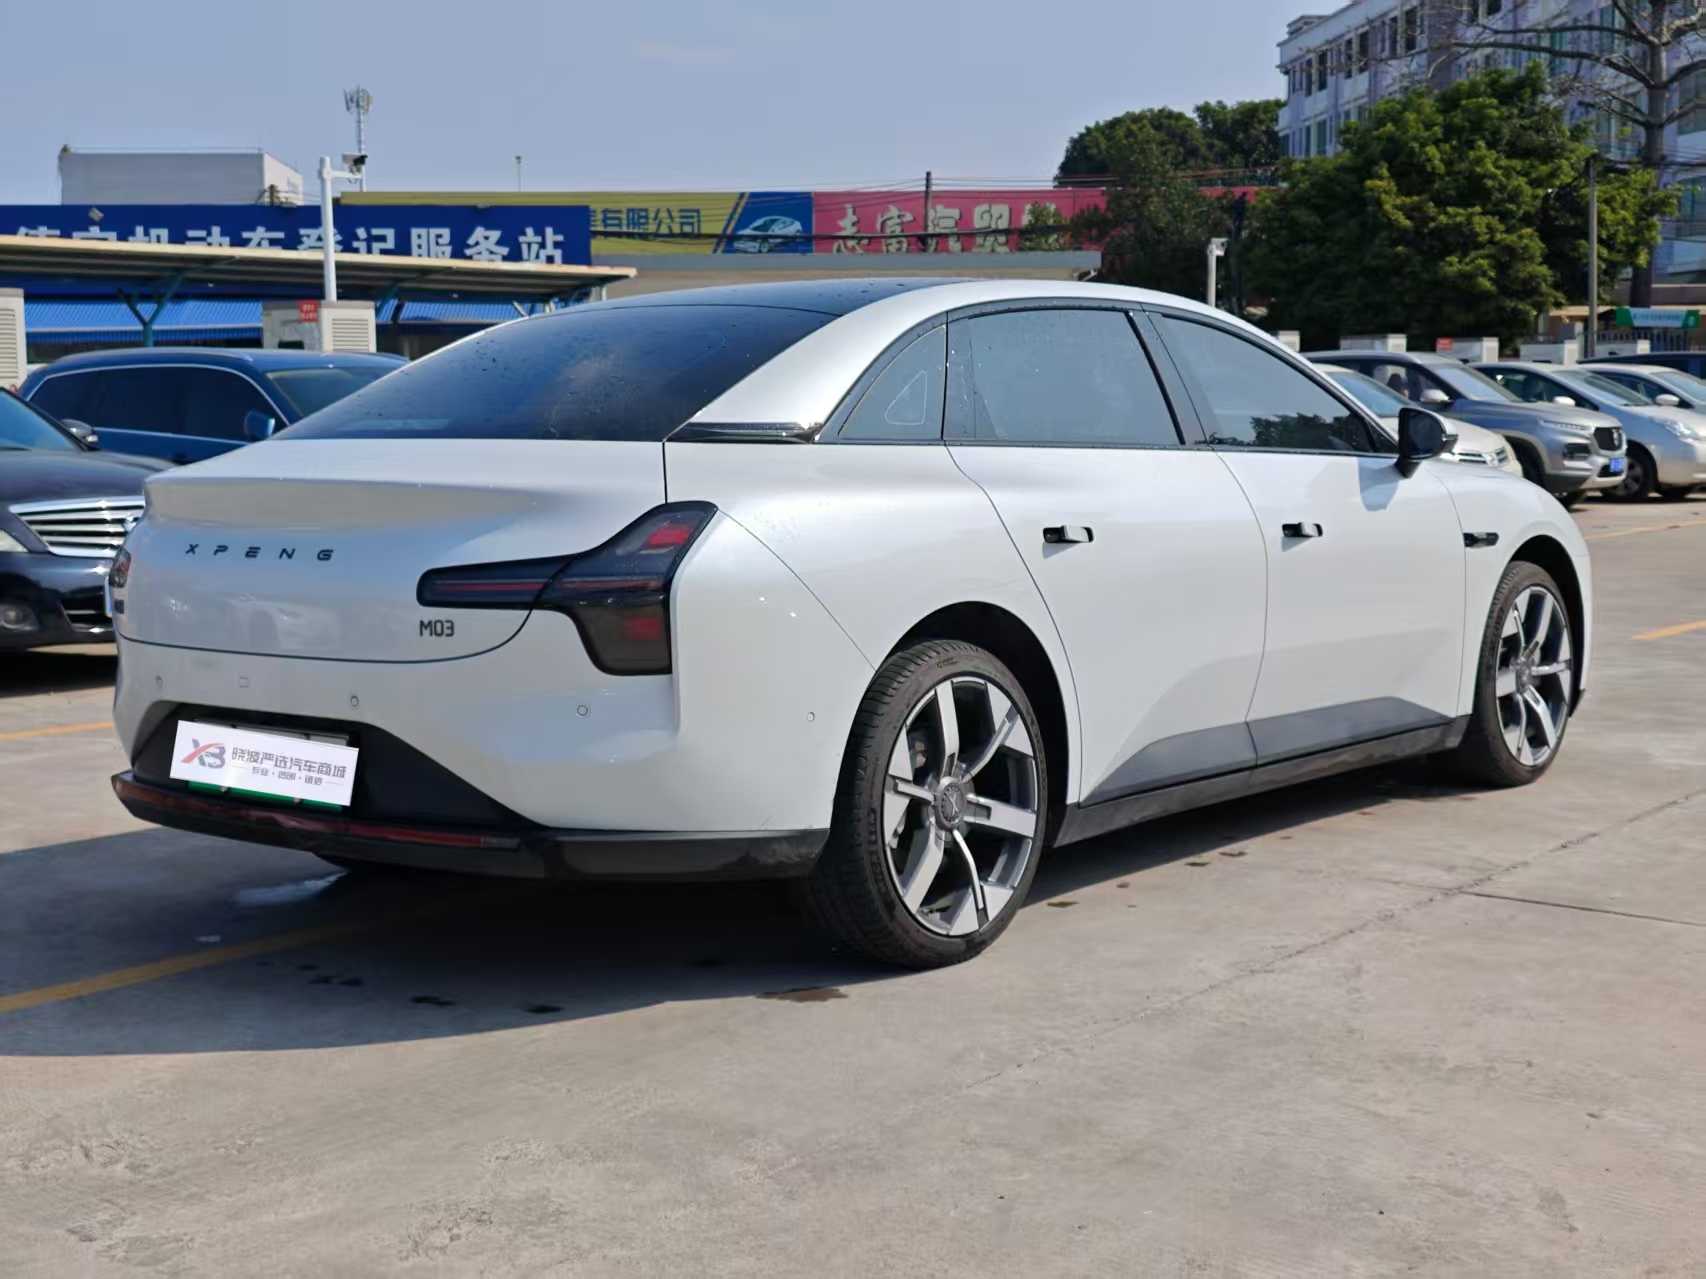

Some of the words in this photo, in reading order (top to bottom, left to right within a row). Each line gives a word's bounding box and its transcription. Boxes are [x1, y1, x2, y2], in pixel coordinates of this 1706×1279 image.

[591, 207, 701, 236] 有限公司
[832, 202, 1058, 253] 志富汽贸
[16, 225, 565, 265] 动车记服务站
[185, 543, 334, 561] XPENG
[419, 619, 454, 637] M03
